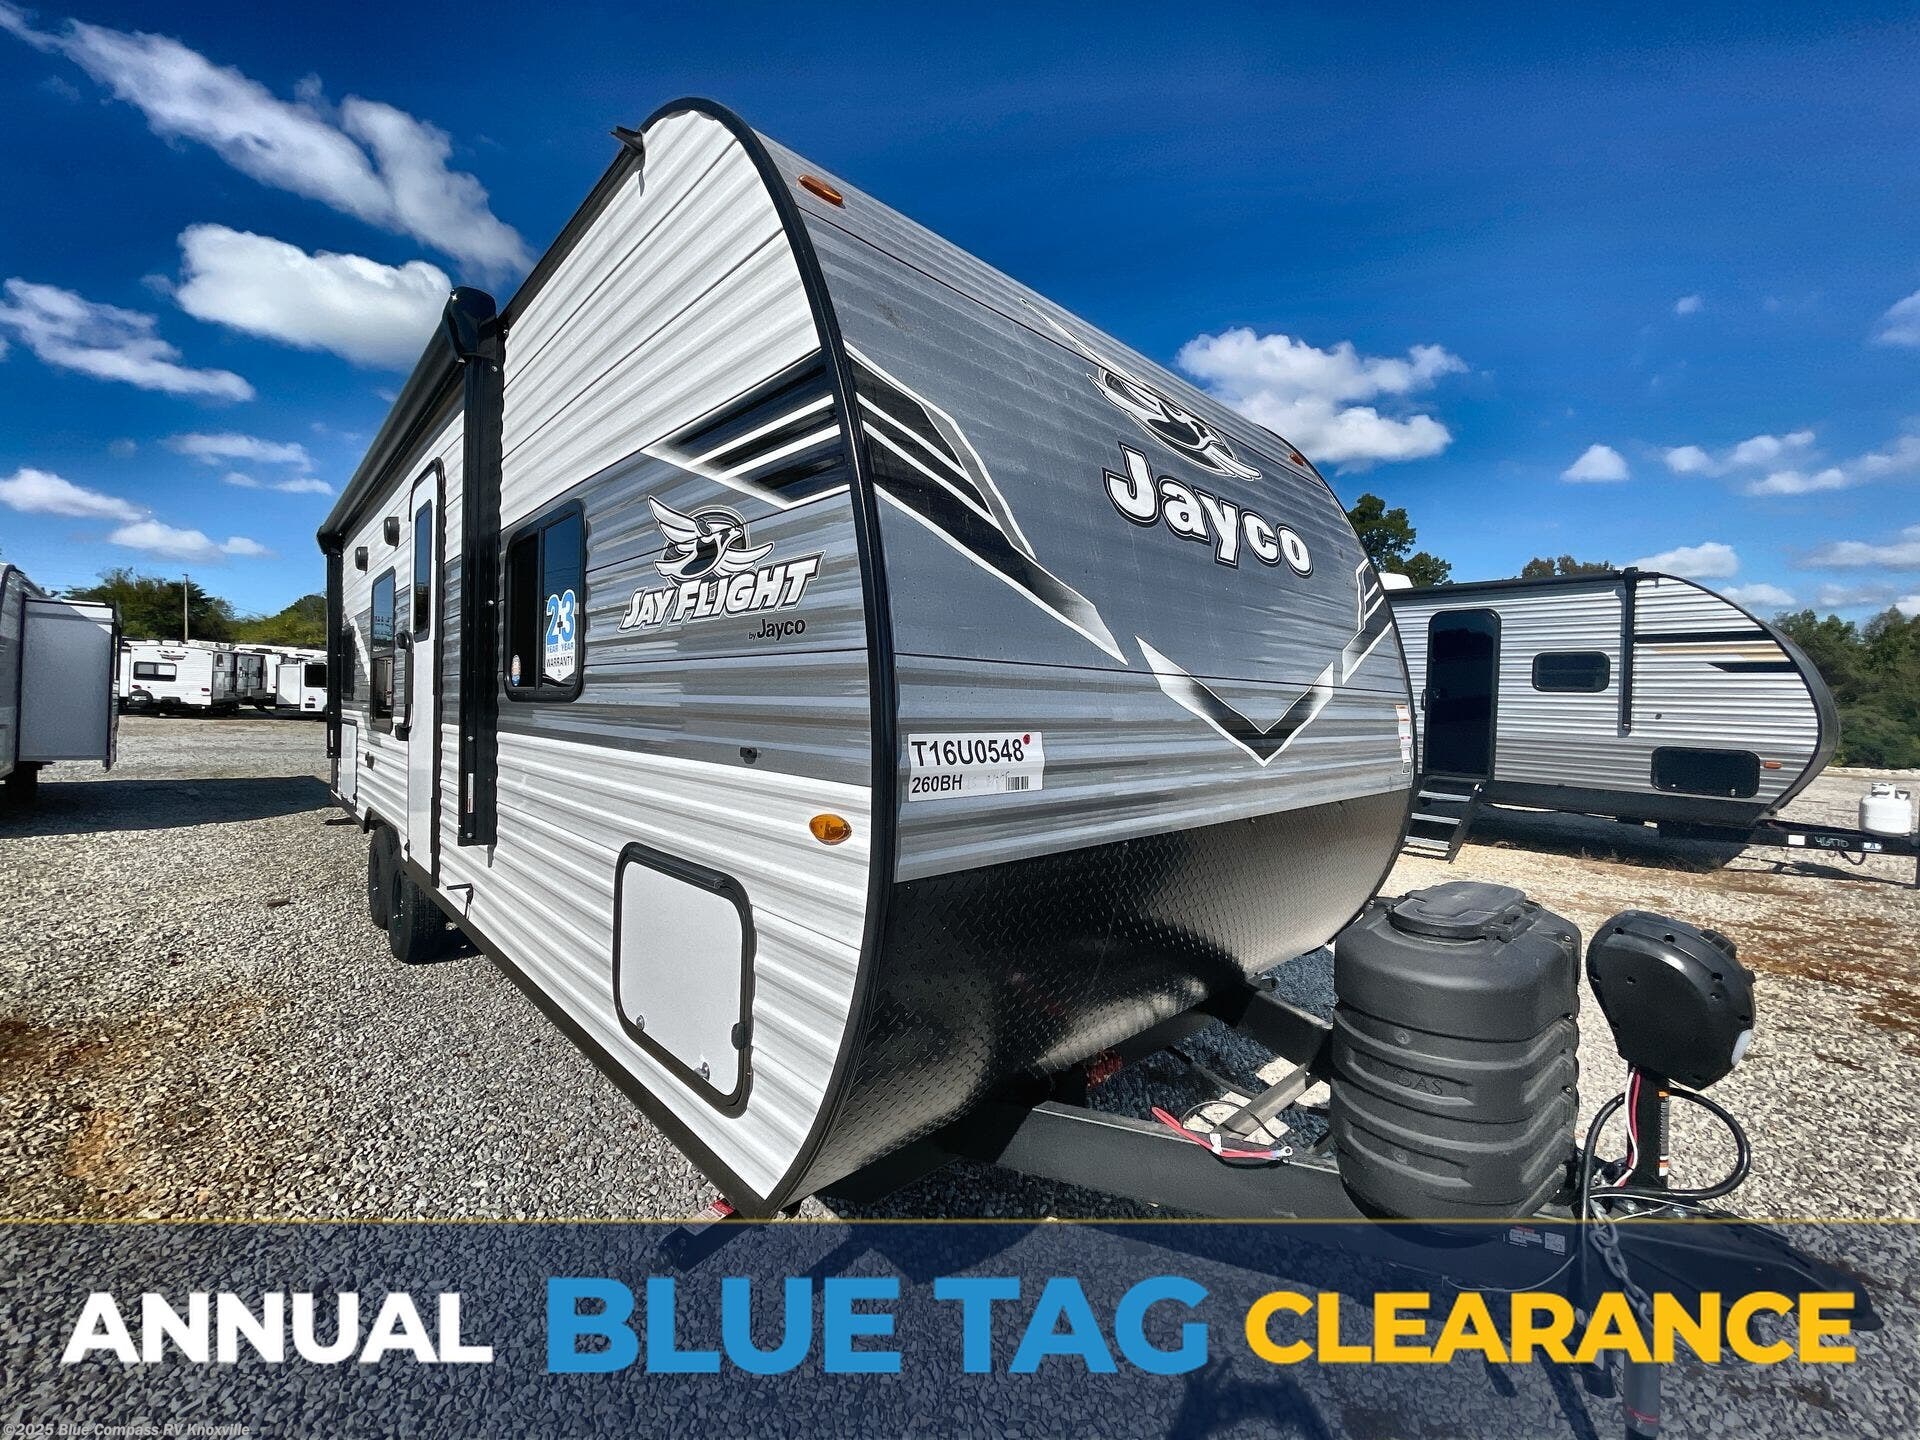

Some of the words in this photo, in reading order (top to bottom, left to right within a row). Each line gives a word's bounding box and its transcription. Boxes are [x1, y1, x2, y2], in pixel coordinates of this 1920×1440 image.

[1103, 442, 1312, 577] Jayco
[620, 588, 677, 630] JAY
[674, 556, 822, 621] FLIGHT
[748, 632, 756, 640] by
[757, 618, 806, 641] Jayco
[561, 641, 575, 652] YEAR
[546, 656, 574, 668] WARRANTY
[911, 738, 1025, 767] T16U0548
[911, 774, 963, 794] 260BH
